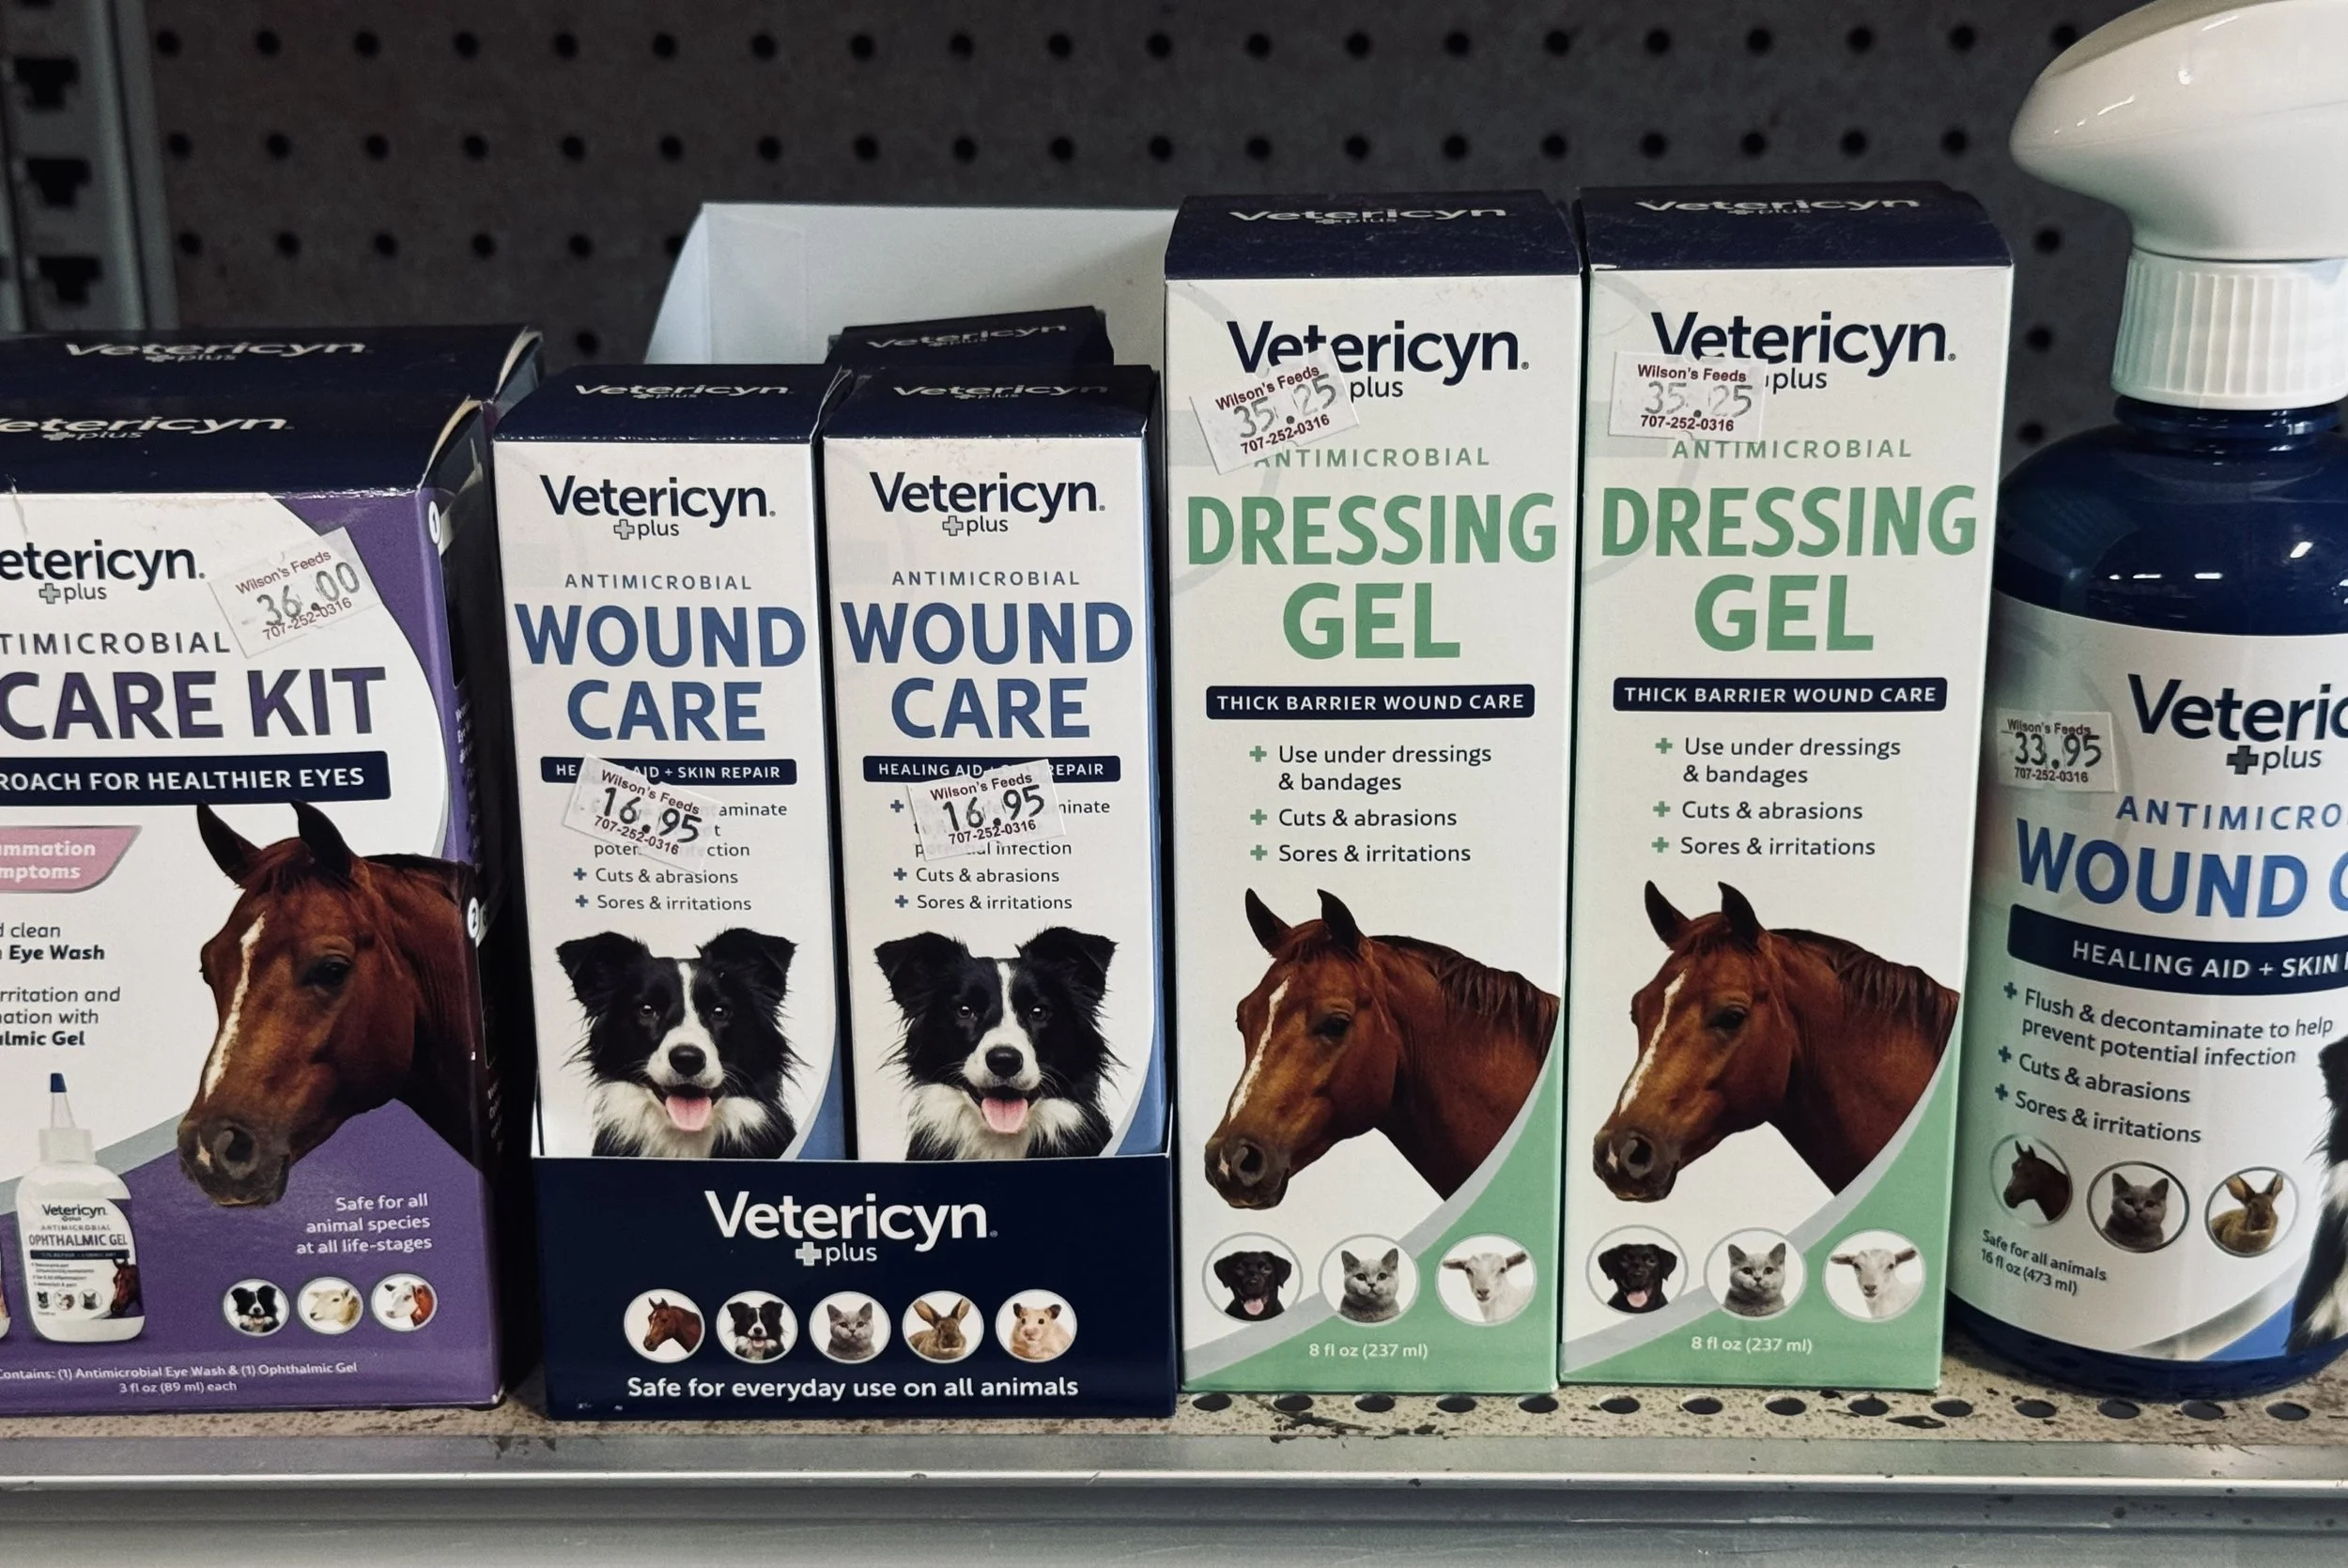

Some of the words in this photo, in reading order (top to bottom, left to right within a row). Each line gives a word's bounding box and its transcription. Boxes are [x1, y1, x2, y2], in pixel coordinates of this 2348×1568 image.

[1637, 363, 1699, 380] Wilson's
[1703, 367, 1747, 383] Feeds
[1772, 368, 1828, 394] plus
[1214, 382, 1275, 411] Wilson's
[1276, 365, 1321, 390] Feeds
[1350, 377, 1404, 403] plus
[1644, 379, 1753, 418] 35.25
[1233, 374, 1336, 438] 35.25
[1240, 413, 1330, 454] 707-252-0316
[1640, 414, 1735, 432] 707-252-0316
[1671, 438, 1912, 459] ANTIMICROBIAL
[638, 518, 680, 541] plus
[965, 515, 1009, 536] plus
[1187, 492, 1558, 566] DRESSING
[1601, 484, 1977, 558] DRESSING
[235, 564, 291, 594] Wilson's
[290, 549, 332, 575] Feeds
[564, 573, 752, 591] ANTIMICROBIAL
[891, 570, 1080, 586] ANTIMICROBIAL
[64, 583, 107, 604] plus
[256, 561, 360, 627] 36.00
[262, 596, 352, 640] 707-252-0316
[1282, 581, 1461, 660] GEL
[1693, 574, 1875, 652] GEL
[514, 603, 807, 668] WOUND
[840, 601, 1133, 665] WOUND
[0, 670, 224, 741] CARE
[247, 666, 387, 738] KIT
[1216, 695, 1279, 712] THICK
[1286, 695, 1377, 712] BARRIER
[1383, 694, 1462, 711] WOUND
[1469, 693, 1524, 710] CARE
[1624, 686, 1688, 703] THICK
[1694, 687, 1785, 703] BARRIER
[1793, 687, 1874, 703] WOUND
[1879, 686, 1936, 703] CARE
[566, 679, 765, 742] CARE
[890, 677, 1090, 739] CARE
[2006, 717, 2052, 735] Wilson's
[2053, 722, 2092, 736] Feeds
[1278, 745, 1318, 764] Use
[1323, 745, 1386, 764] under
[1391, 744, 1492, 766] dressings
[1684, 737, 1723, 756] Use
[1730, 738, 1793, 756] under
[1799, 738, 1902, 760] dressings
[2014, 730, 2102, 770] 33.95
[677, 766, 716, 779] SKIN
[721, 766, 780, 779] REPAIR
[878, 762, 950, 776] HEALING
[2262, 746, 2323, 776] plus
[89, 772, 141, 791] FOR
[147, 769, 291, 791] HEALTHIER
[299, 767, 364, 787] EYES
[1300, 772, 1402, 795] bandages
[1706, 764, 1809, 788] bandages
[2013, 766, 2089, 783] 707-252-0316
[600, 769, 657, 799] Wilson's
[659, 792, 700, 815] Feeds
[930, 781, 989, 802] Wilson's
[991, 772, 1033, 792] Feeds
[603, 787, 703, 843] 16.95
[942, 783, 1045, 833] 16.95
[1278, 808, 1327, 827] Cuts
[1353, 808, 1458, 827] abrasions
[1681, 801, 1730, 820] Cuts
[1758, 801, 1863, 820] abrasions
[594, 815, 679, 855] 707-252-0316
[948, 819, 1037, 845] 707-252-0316
[1278, 844, 1338, 863] Sores
[1366, 844, 1472, 863] irritations
[1680, 837, 1740, 855] Sores
[1769, 837, 1876, 855] irritations
[595, 868, 634, 884] Cuts
[655, 869, 738, 884] abrasions
[915, 868, 954, 884] Cuts
[976, 868, 1059, 884] abrasions
[2016, 817, 2308, 918] WOUND
[597, 894, 644, 911] Sores
[666, 895, 752, 912] irritations
[917, 894, 965, 911] Sores
[986, 895, 1073, 912] irritations
[10, 922, 61, 938] clean
[9, 945, 44, 963] Eye
[50, 945, 105, 961] Wash
[2072, 940, 2193, 976] HEALING
[2201, 959, 2251, 979] AID
[2280, 953, 2339, 977] SKIN
[85, 987, 121, 1003] and
[58, 1008, 100, 1024] with
[2024, 988, 2075, 1020] Flush
[2101, 1009, 2263, 1039] decontaminate
[2269, 1022, 2290, 1038] to
[2294, 1016, 2334, 1038] help
[52, 1031, 85, 1046] Gel
[2021, 1016, 2096, 1052] prevent
[2100, 1038, 2198, 1066] potential
[2204, 1046, 2296, 1067] infection
[2018, 1053, 2060, 1082] Cuts
[2084, 1070, 2191, 1103] abrasions
[2015, 1090, 2067, 1123] Sores
[2093, 1112, 2201, 1144] irritations
[335, 1196, 375, 1211] Safe
[378, 1195, 404, 1209] for
[408, 1192, 428, 1207] all
[306, 1217, 363, 1234] animal
[368, 1215, 431, 1233] species
[703, 1190, 987, 1253] Vetericyn
[28, 1234, 107, 1247] OPHTHALMIC
[109, 1234, 128, 1246] GEL
[296, 1242, 315, 1254] at
[317, 1239, 338, 1253] all
[342, 1237, 433, 1253] life-stages
[826, 1241, 878, 1267] plus
[1982, 1228, 2008, 1252] Safe
[2010, 1240, 2030, 1260] for
[2031, 1252, 2047, 1267] all
[2049, 1258, 2108, 1281] animals
[1981, 1248, 1994, 1265] 16
[2005, 1261, 2021, 1277] oz
[2023, 1266, 2052, 1287] (473
[2055, 1279, 2078, 1297] ml)
[1338, 1345, 1359, 1357] oz
[1362, 1343, 1398, 1360] (237
[1402, 1343, 1429, 1360] ml)
[1722, 1339, 1742, 1350] oz
[1746, 1337, 1783, 1354] (237
[1786, 1337, 1813, 1355] ml)
[75, 1366, 162, 1379] Antimicrobial
[165, 1366, 188, 1379] Eye
[191, 1365, 226, 1377] Wash
[258, 1362, 333, 1376] Ophthalmic
[335, 1361, 358, 1374] Gel
[208, 1381, 238, 1392] each
[626, 1376, 681, 1398] Safe
[687, 1377, 725, 1398] for
[732, 1377, 846, 1402] everyday
[853, 1381, 897, 1397] use
[903, 1381, 936, 1397] on
[943, 1377, 974, 1397] all
[981, 1376, 1079, 1396] animals
